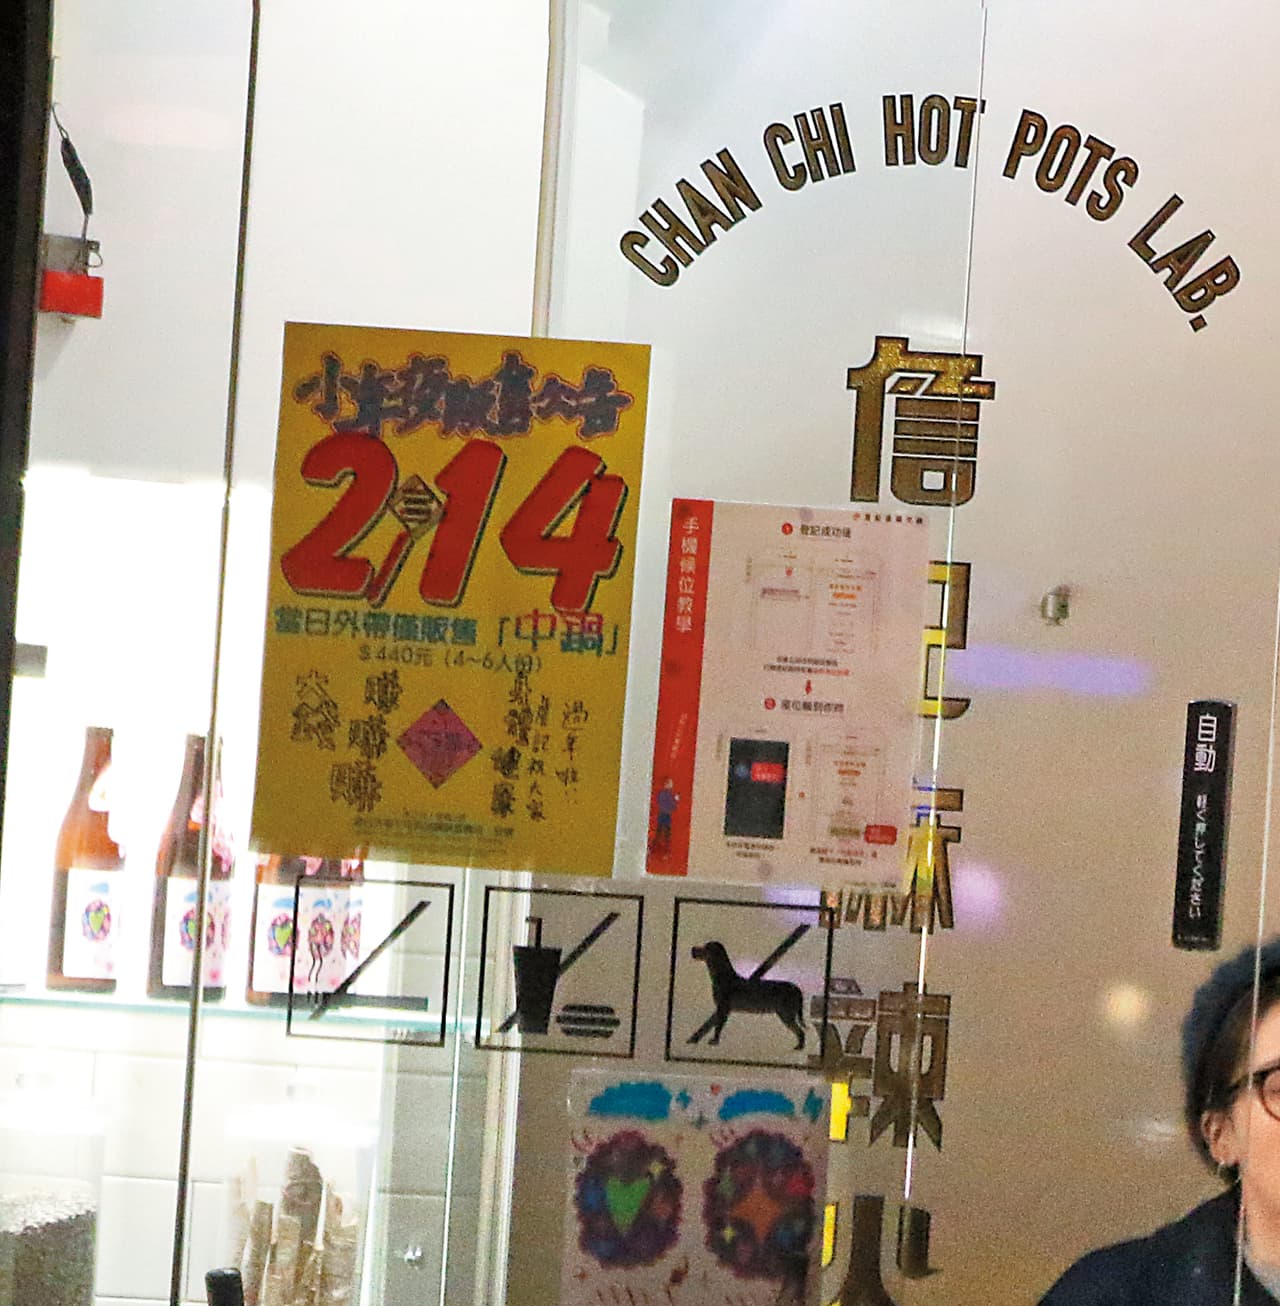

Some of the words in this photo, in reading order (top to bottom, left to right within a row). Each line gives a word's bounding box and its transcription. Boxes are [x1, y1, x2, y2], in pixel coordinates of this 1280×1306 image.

[620, 148, 763, 287] CHAN
[763, 102, 857, 191] CHI
[882, 94, 987, 168] HOT
[1002, 109, 1139, 222] POTS
[1128, 194, 1241, 332] LAB.
